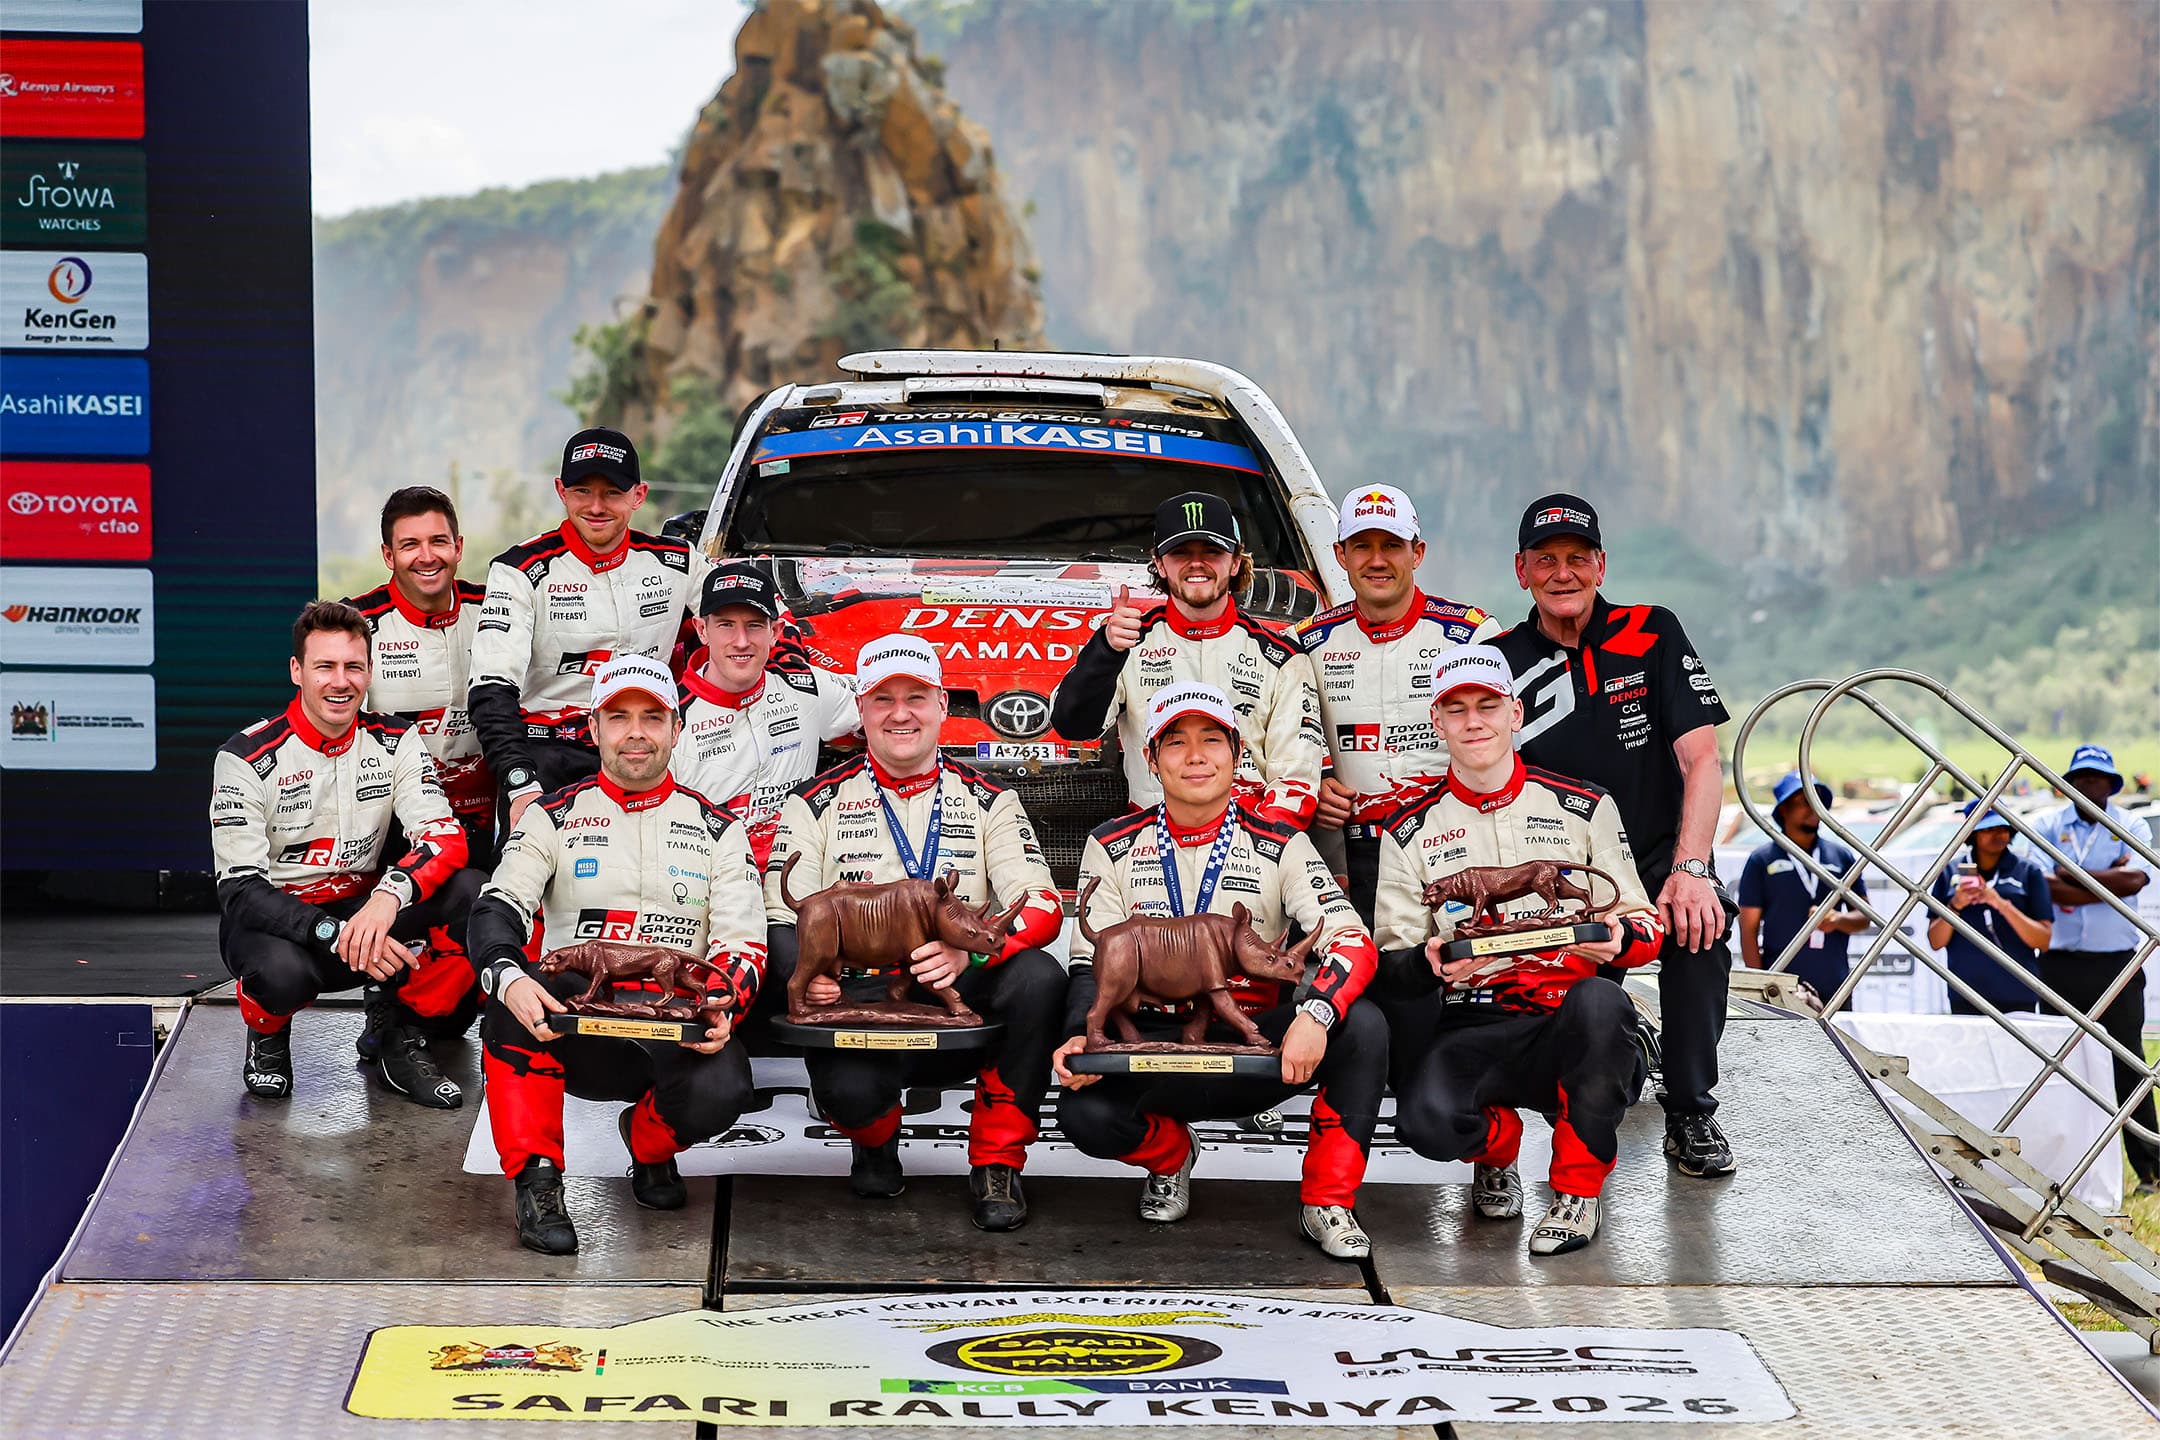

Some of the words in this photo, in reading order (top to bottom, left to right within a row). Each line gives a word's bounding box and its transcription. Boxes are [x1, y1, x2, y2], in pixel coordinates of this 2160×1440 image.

[20, 81, 59, 93] Kenya
[63, 82, 115, 94] Airways
[18, 175, 115, 208] STOWA
[39, 218, 101, 231] WATCHES
[25, 308, 116, 329] KenGen
[25, 334, 53, 343] Energy
[56, 334, 67, 343] for
[814, 415, 864, 428] GR
[874, 412, 988, 422] TOYOTA
[995, 412, 1100, 424] GAZOO
[1108, 418, 1203, 437] Racing
[572, 449, 594, 460] GR
[598, 443, 627, 454] TOYOTA
[44, 496, 139, 513] TOYOTA
[1355, 505, 1374, 518] Red
[1376, 505, 1396, 518] Bull
[1537, 514, 1560, 524] GR
[99, 520, 139, 533] cfao
[664, 553, 686, 565] OMP
[528, 563, 546, 579] OMP
[548, 583, 588, 592] DENSO
[636, 588, 673, 600] TAMADIC
[640, 604, 669, 614] CENTRAL
[54, 624, 91, 635] driving
[95, 625, 139, 634] emotion
[1449, 627, 1470, 638] OMP
[1304, 631, 1323, 645] OMP
[378, 641, 419, 651] DENSO
[381, 652, 416, 660] Panasonic
[1139, 647, 1177, 659] DENSO
[1265, 646, 1285, 660] OMP
[1323, 651, 1361, 661] DENSO
[1227, 663, 1264, 681] TAMADIC
[789, 675, 813, 685] OMP
[1609, 687, 1648, 705] DENSO
[763, 703, 799, 720] TAMADIC
[691, 714, 734, 734] DENSO
[768, 721, 799, 735] CENTRAL
[528, 727, 549, 735] OMP
[696, 727, 731, 741] Panasonic
[697, 734, 732, 748] AUTOMOTIVE
[1339, 735, 1379, 751] GR
[1386, 741, 1439, 753] Racing
[256, 757, 272, 772] OMP
[278, 769, 313, 786] DENSO
[356, 770, 393, 784] AMADIC
[281, 782, 310, 795] Panasonic
[357, 787, 391, 798] CENTRAL
[280, 790, 311, 801] AUTOMOTIVE
[626, 801, 643, 809] GR
[837, 799, 882, 811] DENSO
[1565, 796, 1590, 809] OMP
[839, 810, 876, 820] Panasonic
[1527, 817, 1563, 825] Panasonic
[564, 817, 610, 830] DENSO
[1398, 818, 1418, 836] OMP
[1527, 823, 1565, 832] AUTOMOTIVE
[1423, 828, 1466, 848] DENSO
[1525, 836, 1570, 845] TAMADIC
[666, 841, 711, 856] TAMADIC
[1109, 839, 1131, 853] OMP
[1257, 841, 1280, 854] OMP
[283, 849, 333, 866] GR
[644, 913, 701, 928] TOYOTA
[577, 921, 632, 939] GR
[642, 925, 695, 936] GAZOO
[641, 935, 693, 948] Racing
[697, 1316, 762, 1329] THE
[767, 1305, 869, 1324] GREAT
[880, 1296, 1017, 1312] KENYAN
[1031, 1296, 1248, 1312] EXPERIENCE
[1256, 1305, 1291, 1316] IN
[1298, 1310, 1416, 1323] AFRICA
[998, 1338, 1144, 1348] SAFARI
[1012, 1357, 1138, 1367] RALLY
[956, 1382, 1025, 1393] KCB
[1128, 1380, 1233, 1392] BANK
[452, 1394, 787, 1417] SAFARI
[829, 1399, 1109, 1417] RALLY
[1145, 1396, 1456, 1417] KENYA
[1488, 1396, 1740, 1415] 2026
